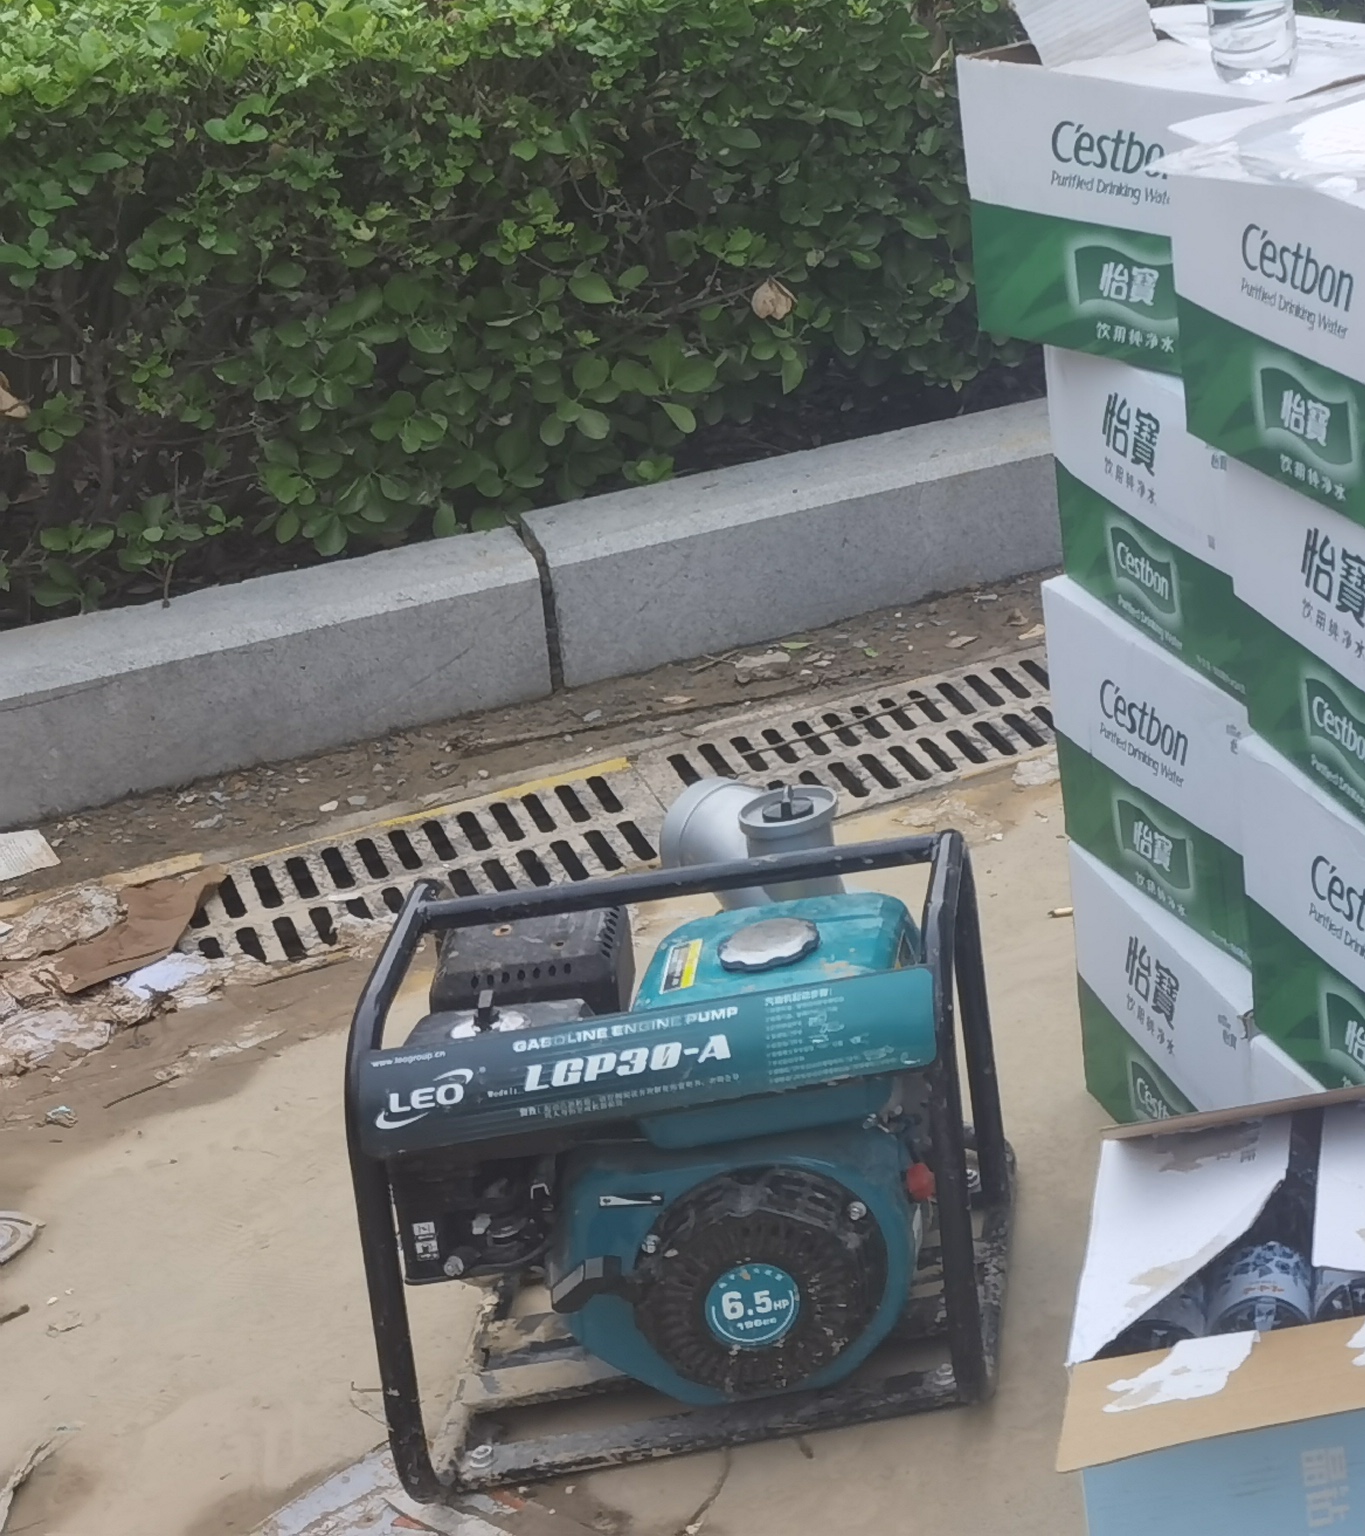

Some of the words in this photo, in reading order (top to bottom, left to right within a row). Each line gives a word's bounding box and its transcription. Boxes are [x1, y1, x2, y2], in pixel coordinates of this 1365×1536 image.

[1051, 120, 1168, 180] C'estbo
[1096, 178, 1142, 205] Drinking
[1144, 187, 1171, 205] Wat
[1241, 223, 1355, 312] C'estbon
[1095, 321, 1175, 353] 饮用纯净水
[1100, 678, 1189, 767] C'estbon
[512, 1027, 608, 1054] GASOLINE
[611, 1015, 683, 1038] ENGINE
[684, 1005, 739, 1026] PUMP
[524, 1033, 732, 1093] LGP30-A
[389, 1083, 465, 1114] LEO
[721, 1289, 773, 1321] 6.5
[773, 1298, 790, 1312] HP
